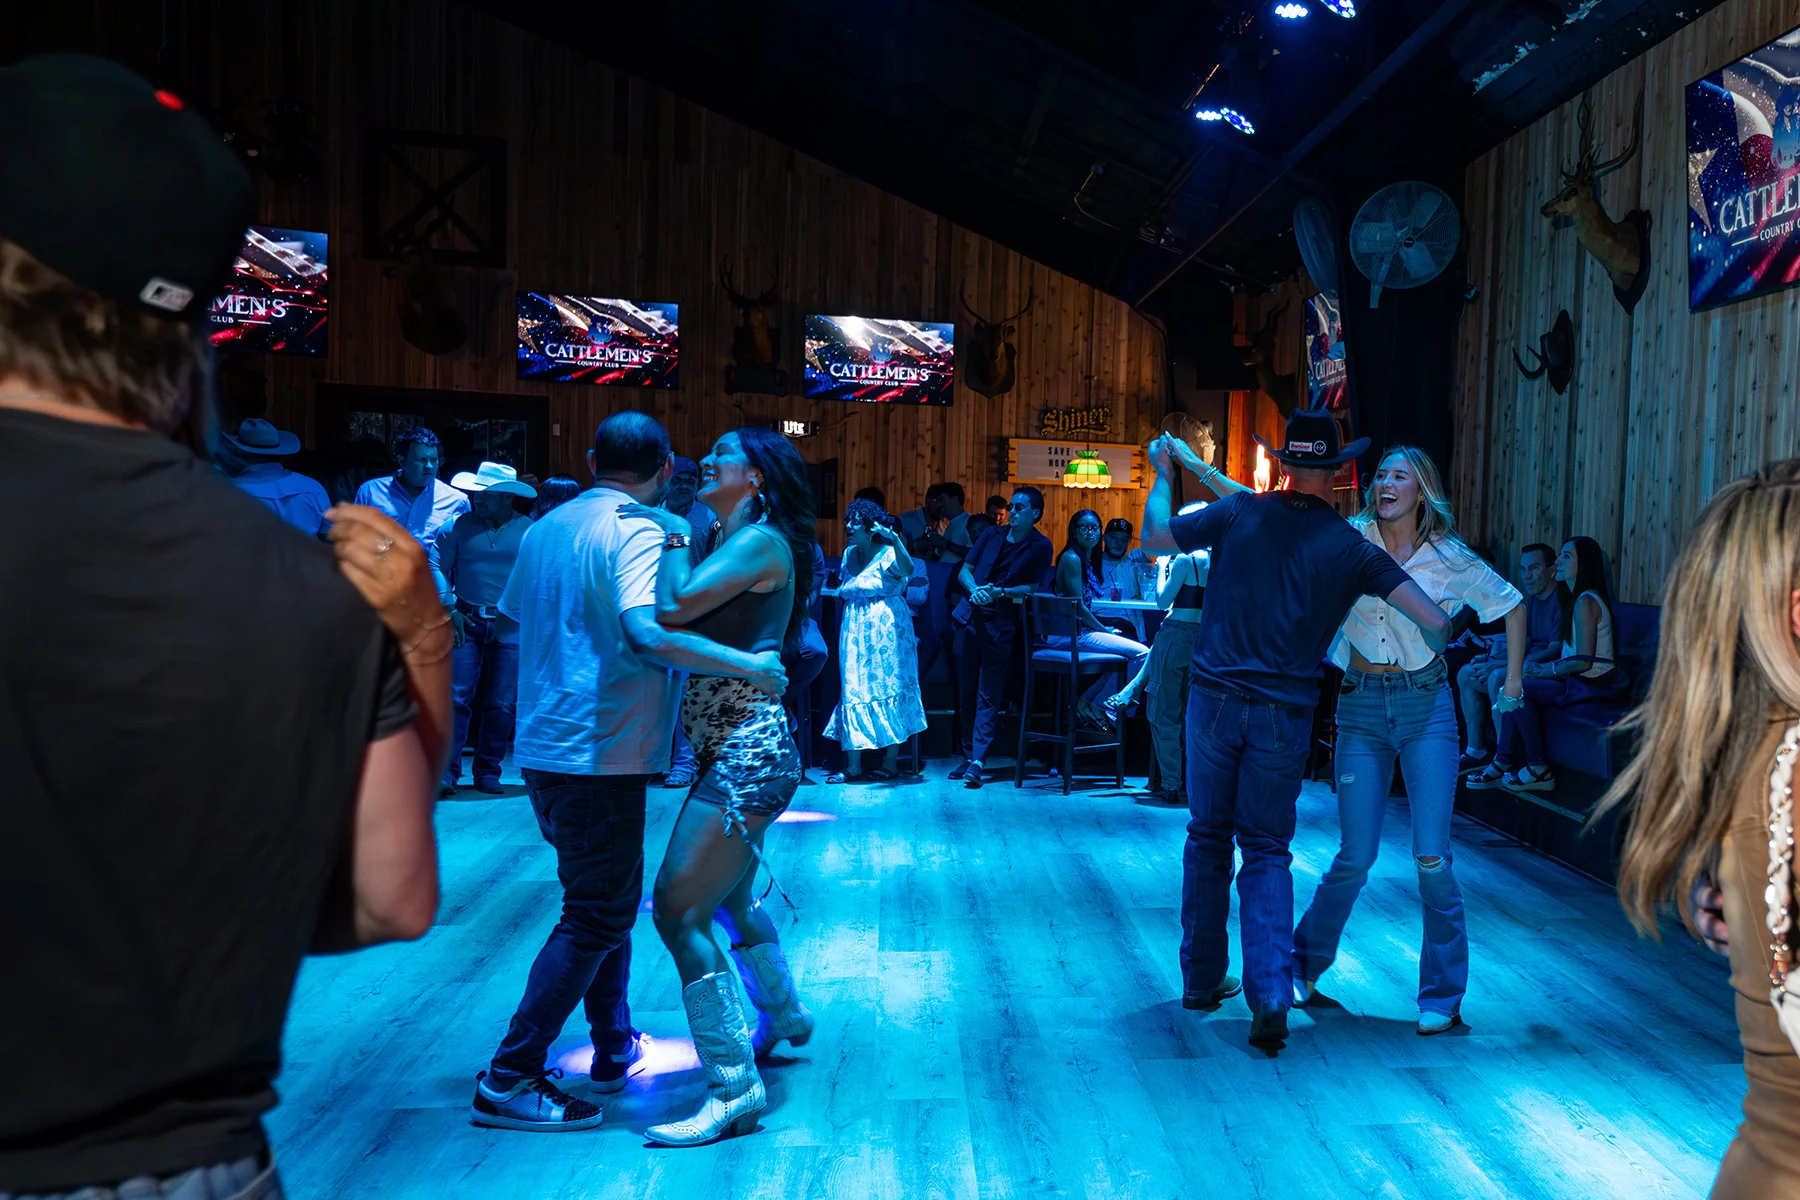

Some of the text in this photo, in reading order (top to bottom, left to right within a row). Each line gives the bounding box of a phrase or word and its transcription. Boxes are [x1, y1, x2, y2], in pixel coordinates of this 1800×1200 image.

[1720, 173, 1800, 233] CATTLE
[1760, 220, 1795, 240] COUNTRY
[211, 315, 234, 323] CLUB
[544, 343, 653, 363] CATTLEMEN'S
[577, 360, 603, 368] COUNTRY
[829, 363, 930, 382] CATTLEMEN'S
[1041, 405, 1112, 437] Shiner
[1048, 446, 1071, 456] SAVE
